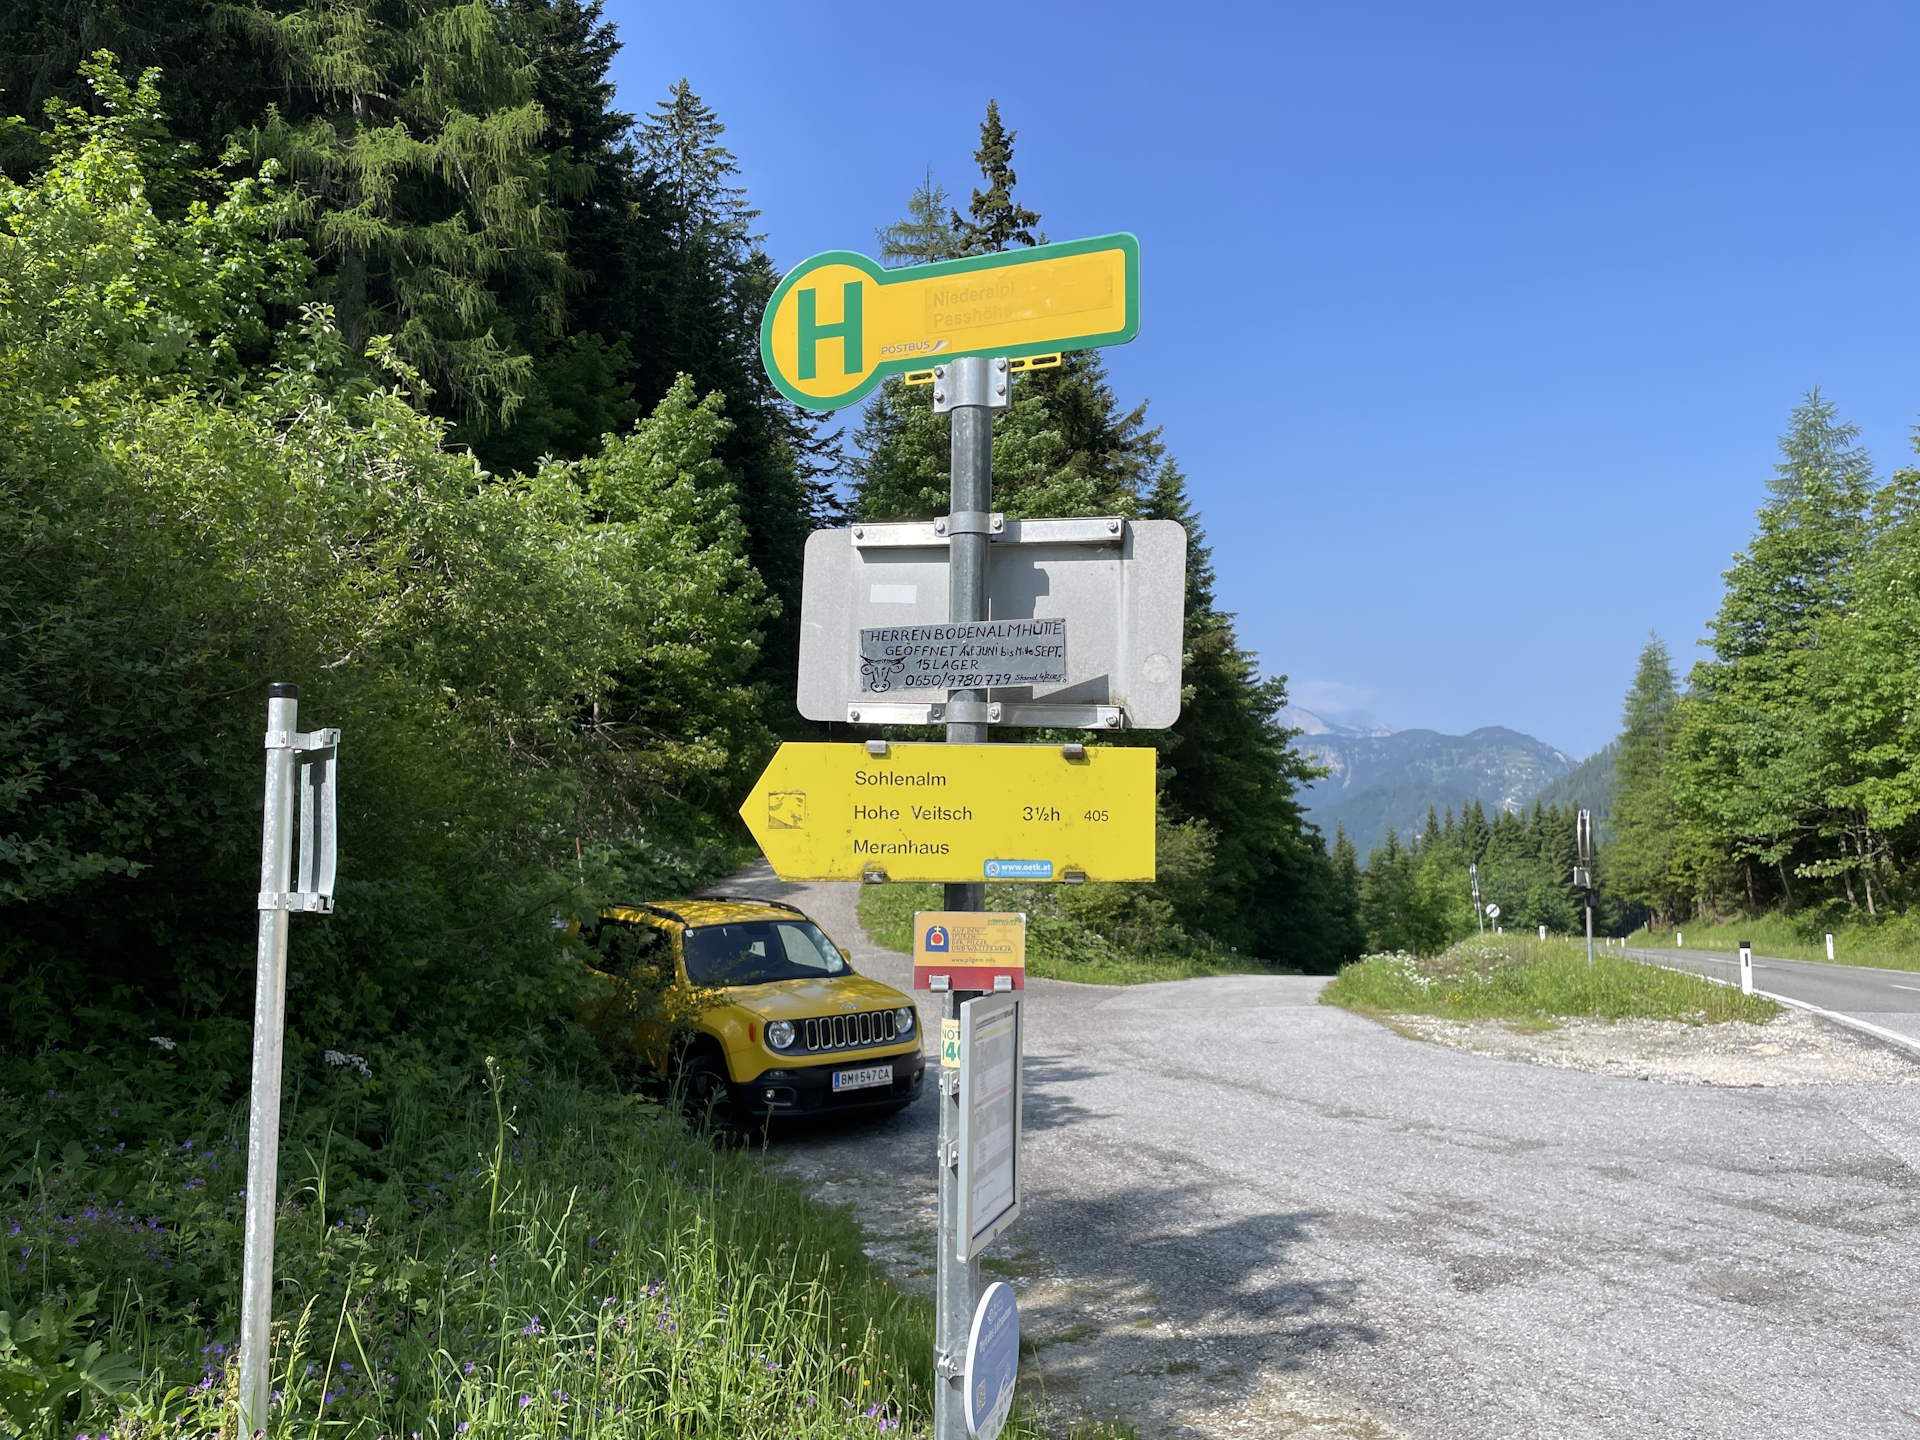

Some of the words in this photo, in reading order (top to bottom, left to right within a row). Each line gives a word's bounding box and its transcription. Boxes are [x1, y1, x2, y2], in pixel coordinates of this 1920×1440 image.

[933, 281, 1015, 308] Niederalpl
[933, 304, 1014, 329] Passhöhe
[798, 281, 863, 381] H
[881, 340, 930, 355] POSTBUS
[885, 641, 958, 657] GEÖFFNET
[1000, 646, 1014, 658] bis
[1033, 645, 1062, 658] SEPT.
[905, 673, 1012, 690] 0650/9780779
[1015, 673, 1038, 681] Stand
[855, 770, 946, 786] Sohlenalm
[854, 805, 900, 820] Hohe
[911, 805, 972, 820] Veitsch
[1083, 810, 1109, 822] 405
[854, 839, 950, 854] Meranhaus
[1001, 863, 1051, 871] www.oetk.at
